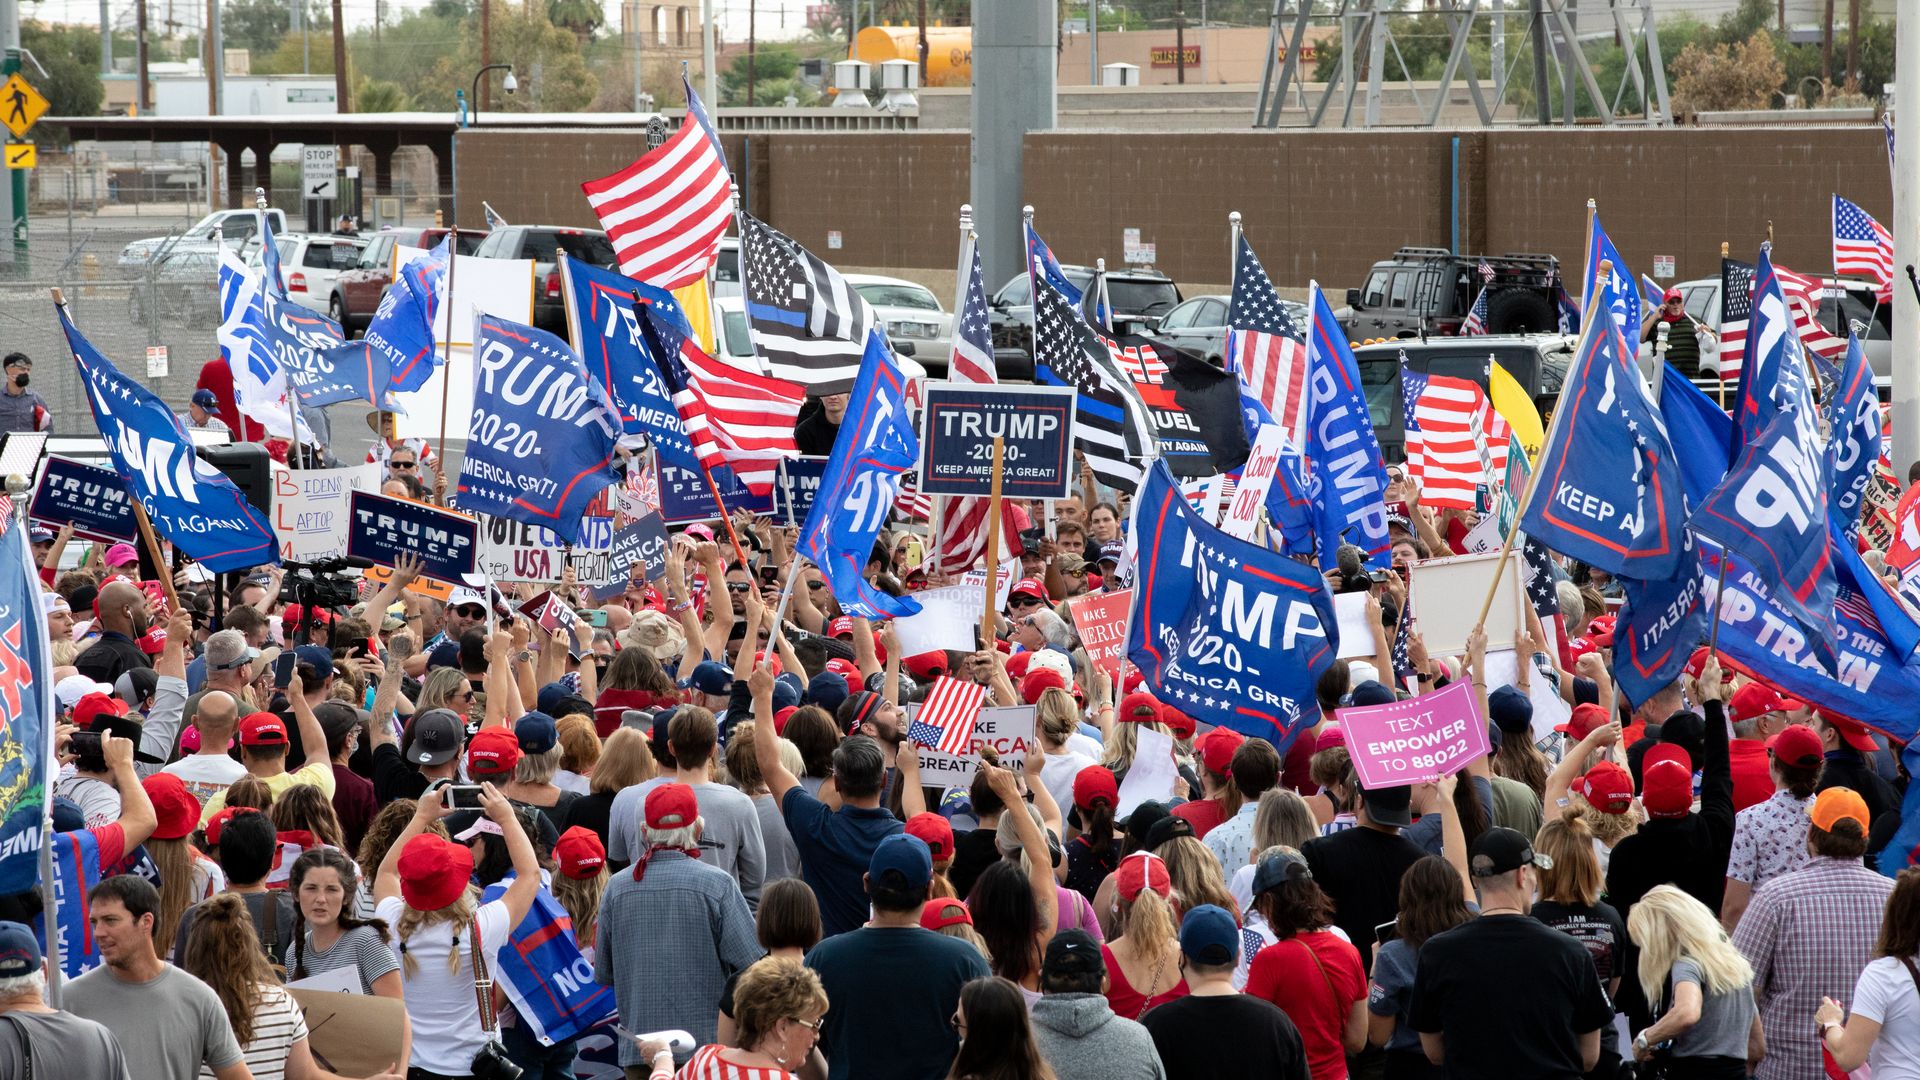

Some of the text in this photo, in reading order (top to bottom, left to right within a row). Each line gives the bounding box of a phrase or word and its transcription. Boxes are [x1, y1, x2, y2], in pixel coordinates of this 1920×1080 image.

[1151, 50, 1173, 64] WELLS
[306, 150, 333, 160] STOP
[367, 331, 406, 366] GREAT!
[629, 404, 688, 436] AMERIC
[940, 411, 1058, 440] TRUMP
[966, 444, 1027, 461] -200-
[1175, 441, 1209, 453] AGAIN
[936, 465, 1055, 478] KEEP AMERCA GREAT!
[1246, 444, 1279, 479] Count
[50, 489, 130, 516] PENCE
[56, 501, 118, 520] KEEP AMERICA GREAT!
[683, 494, 699, 502] KEEP
[1233, 489, 1262, 522] OUR
[1556, 480, 1616, 521] KEEP
[30, 526, 53, 536] TRUMP
[73, 522, 89, 530] 2020
[356, 508, 470, 549] TRUMP
[366, 526, 459, 559] PENCE
[375, 541, 392, 549] KEEP
[424, 553, 448, 564] GREAT!
[514, 549, 551, 580] USA
[1083, 608, 1108, 622] MAKE
[1738, 571, 1768, 600] ALL
[1850, 631, 1886, 658] THE
[1385, 711, 1434, 734] TEXT
[1367, 719, 1467, 756] EMPOWER
[1378, 739, 1469, 773] TO 88022
[1573, 915, 1587, 923] AM
